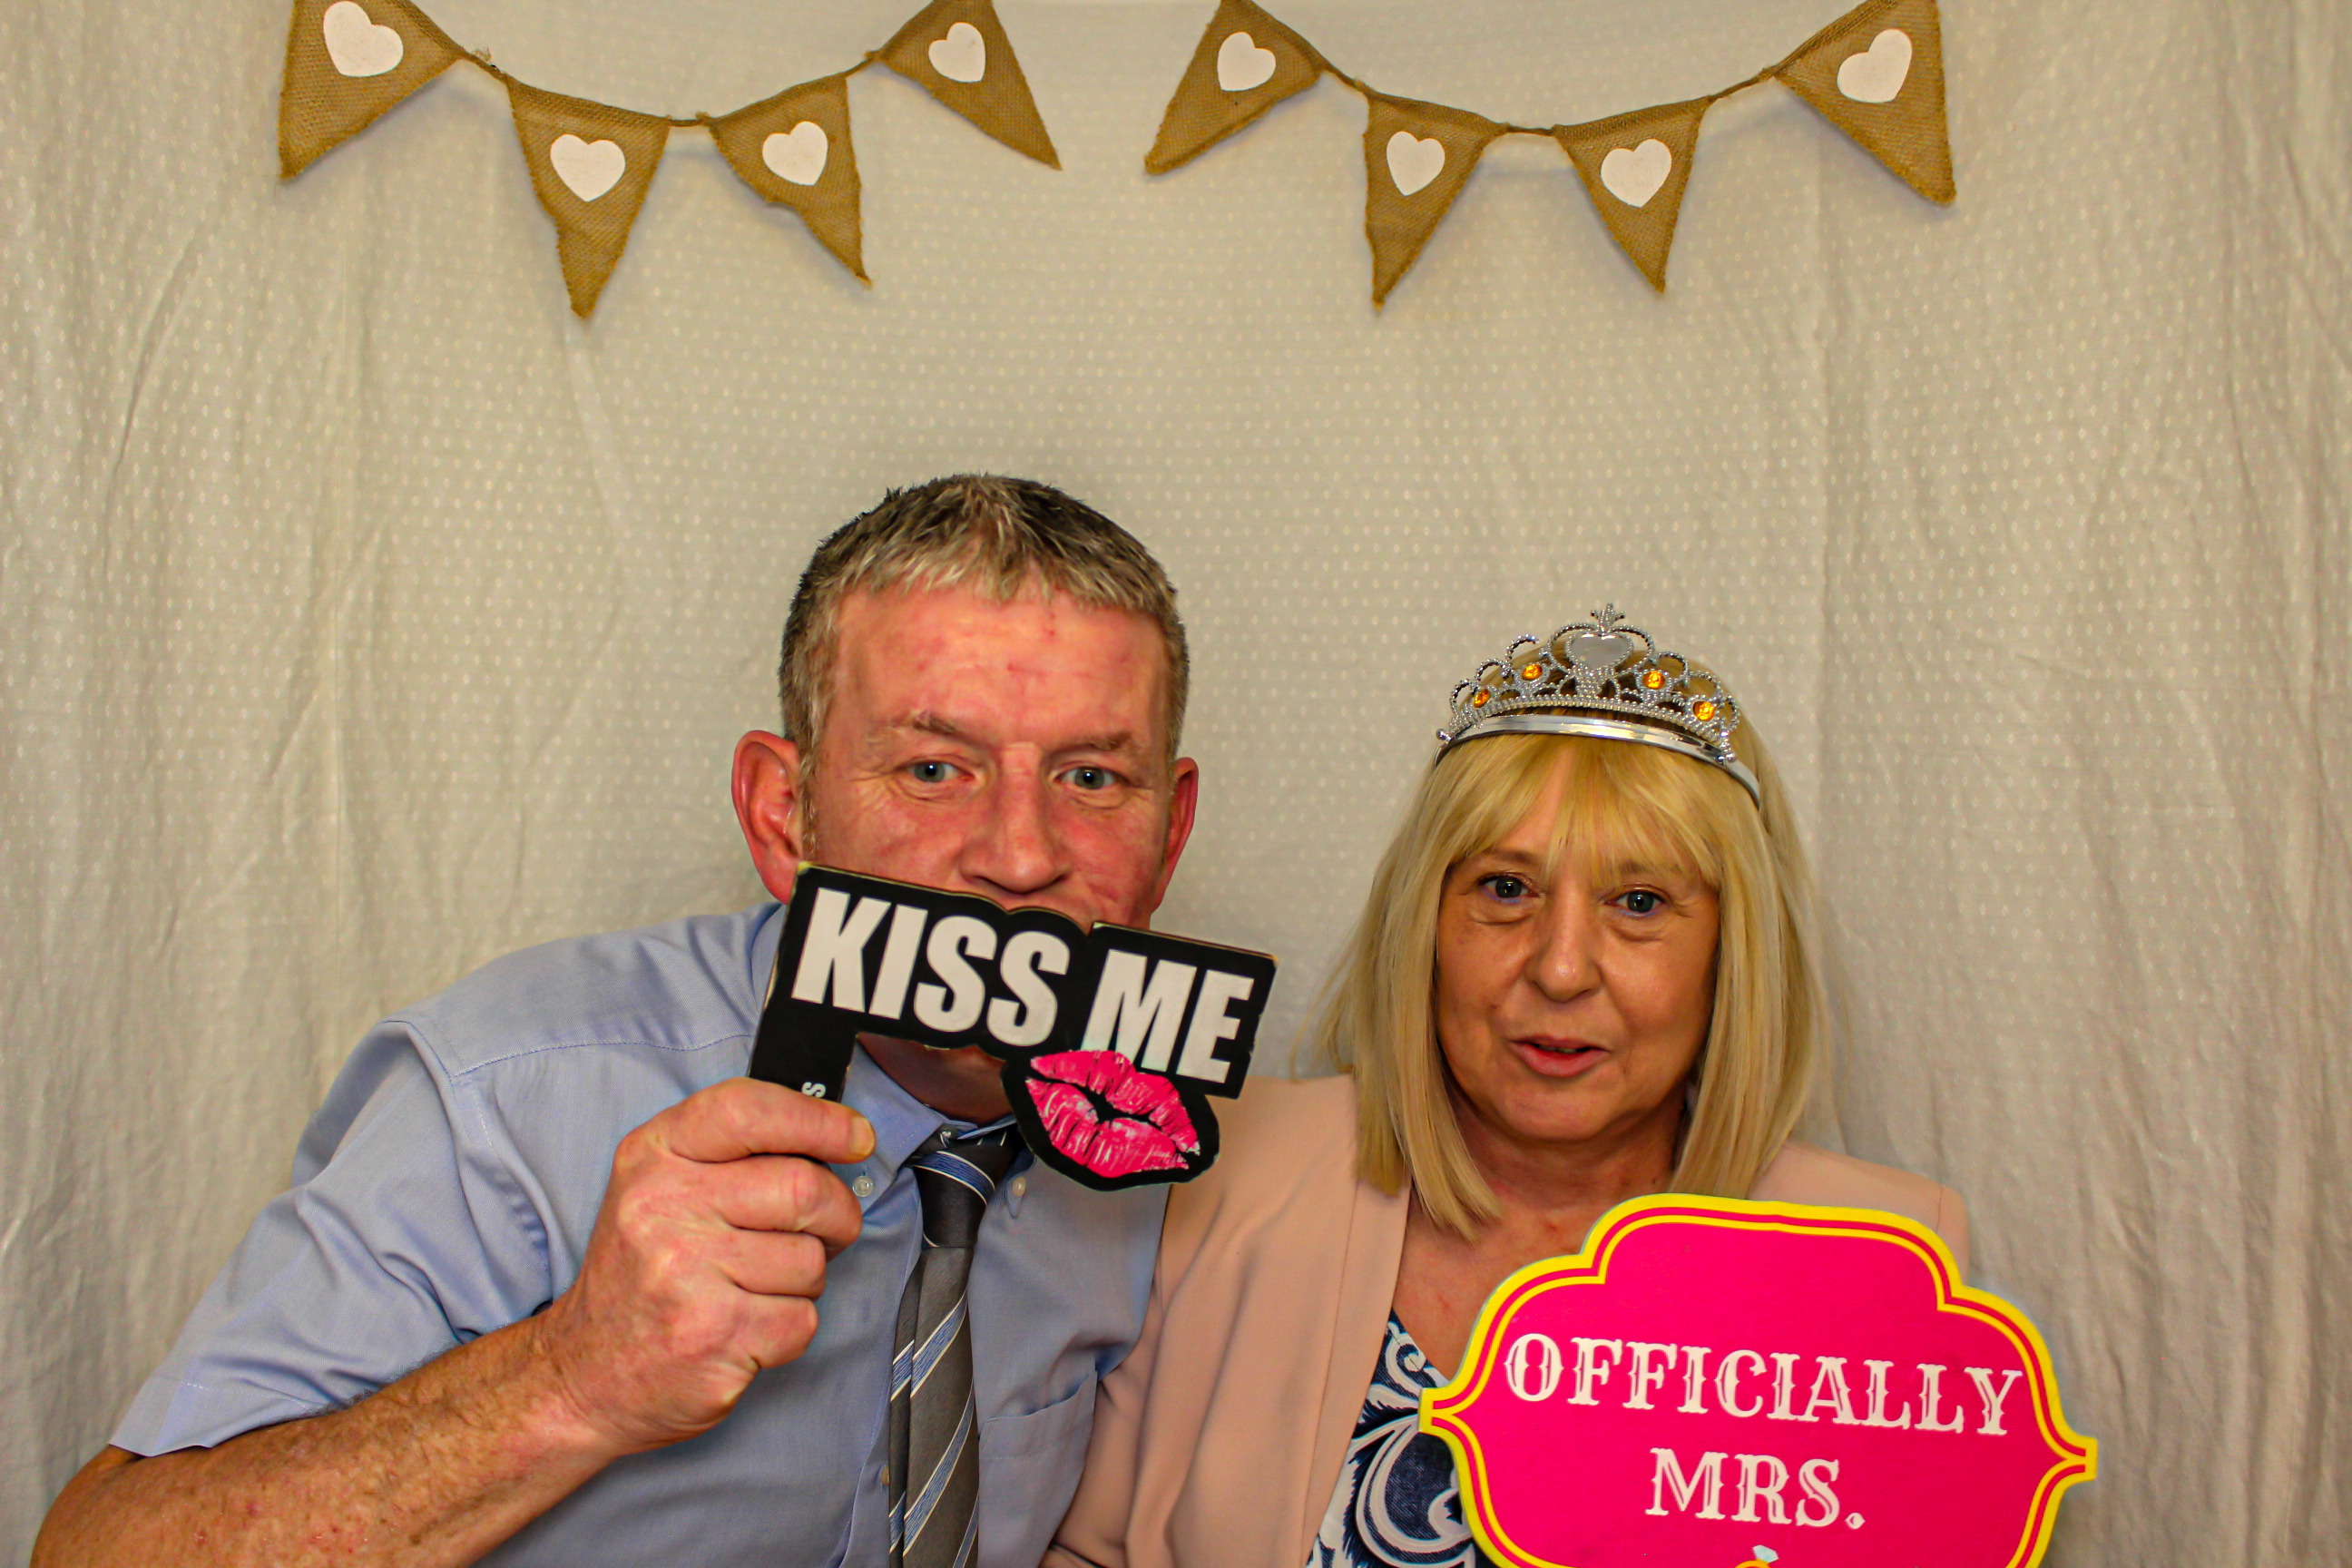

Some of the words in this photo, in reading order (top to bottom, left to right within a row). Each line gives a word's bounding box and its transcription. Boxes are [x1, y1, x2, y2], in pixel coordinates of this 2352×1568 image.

[791, 887, 1071, 1047] KISS
[1081, 949, 1254, 1083] ME
[1504, 1333, 2022, 1436] OFFICIALLY
[1645, 1448, 1866, 1529] MRS.
